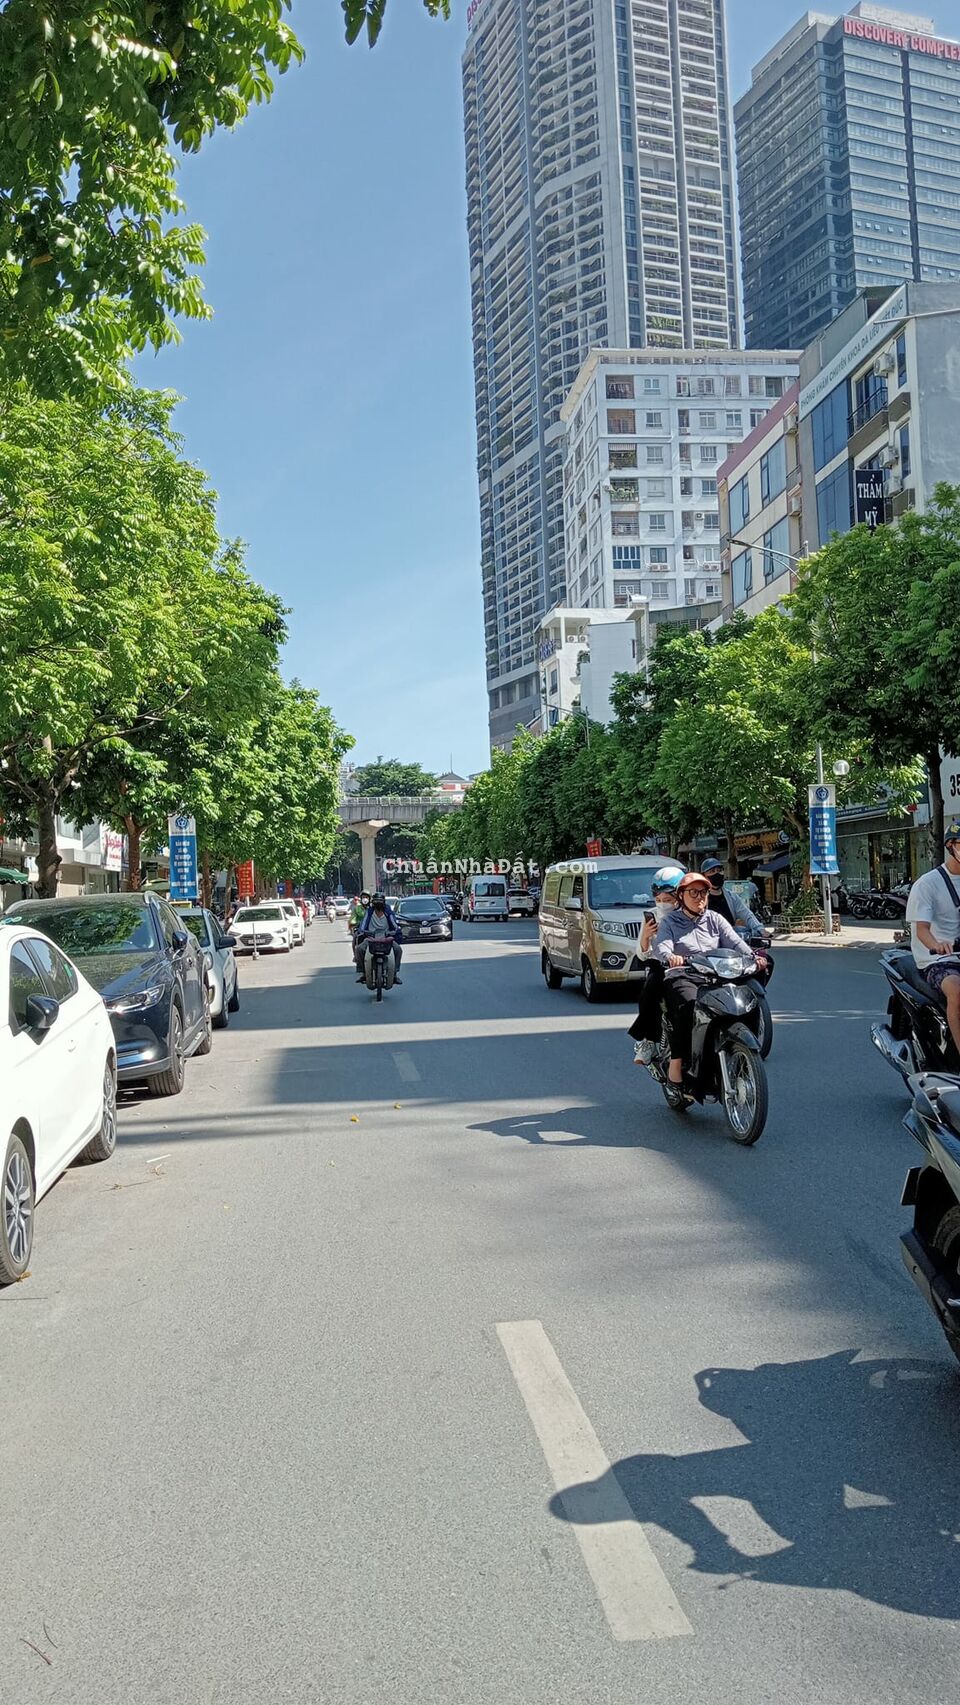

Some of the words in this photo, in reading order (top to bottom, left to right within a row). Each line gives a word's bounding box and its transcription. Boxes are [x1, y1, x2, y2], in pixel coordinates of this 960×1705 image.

[844, 20, 906, 48] DISCOVERY
[911, 36, 960, 60] COMPLE
[847, 342, 861, 363] KHOA
[857, 474, 882, 499] THẨM
[864, 506, 878, 526] MỸ
